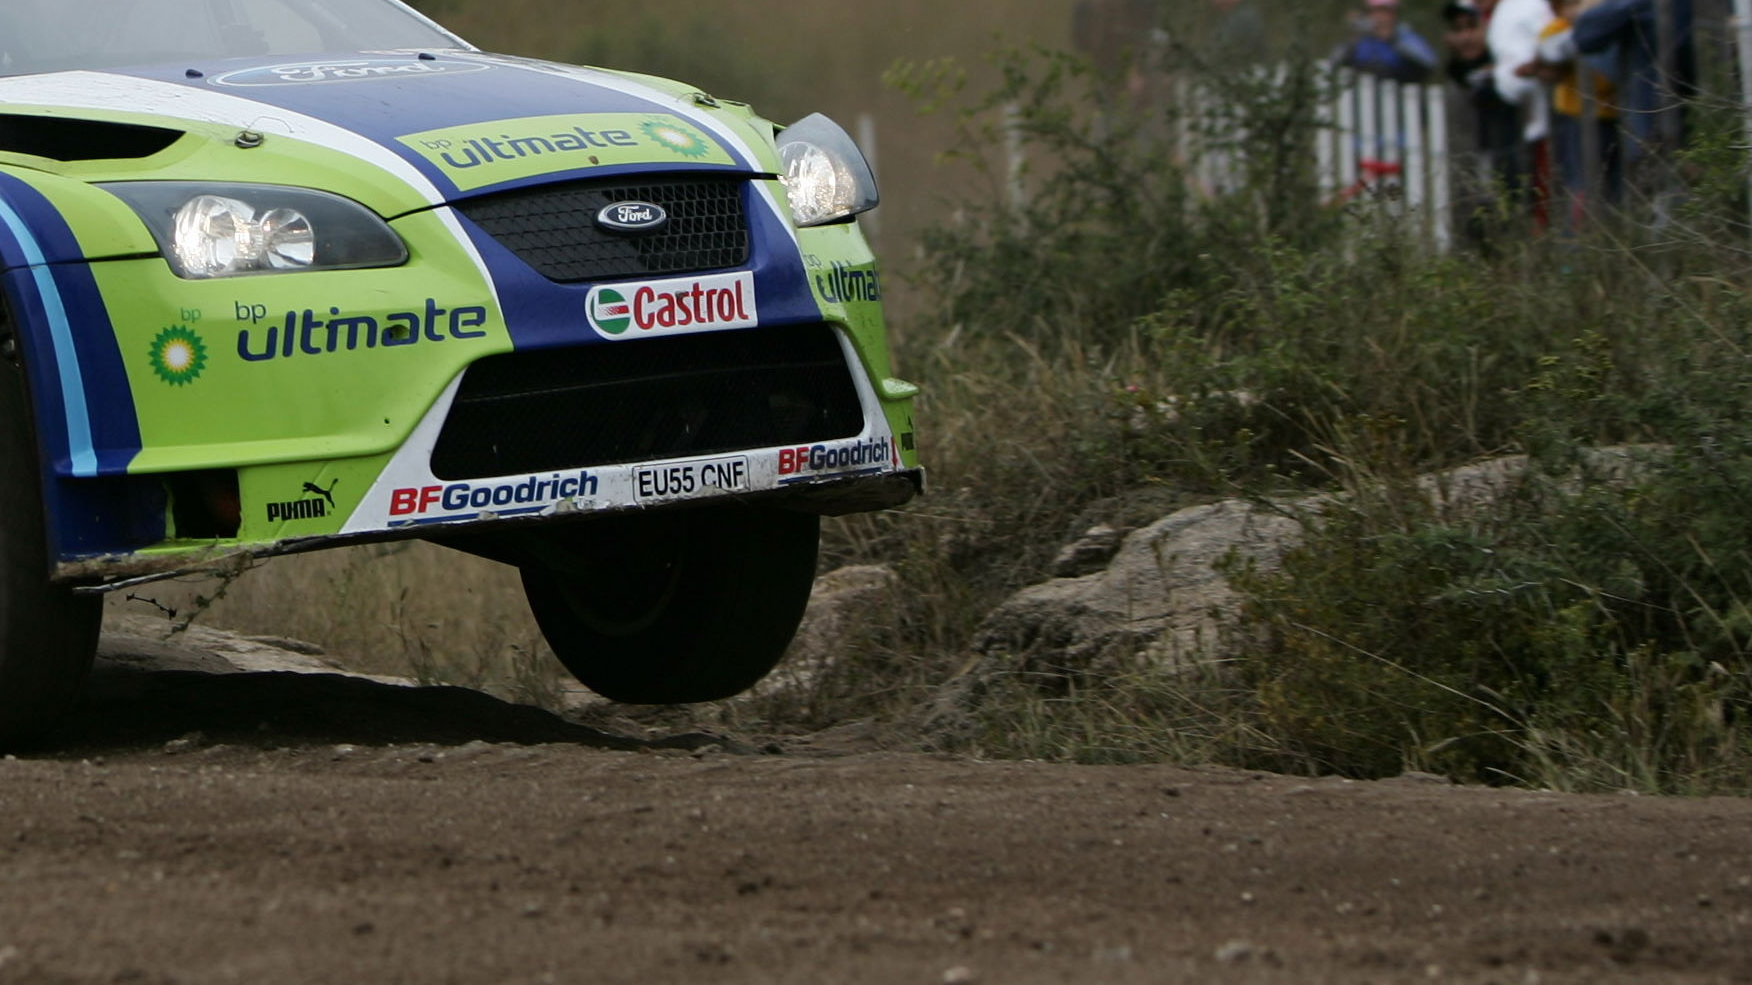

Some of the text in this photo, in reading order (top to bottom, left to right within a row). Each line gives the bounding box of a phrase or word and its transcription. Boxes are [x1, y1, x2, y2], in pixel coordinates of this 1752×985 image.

[270, 61, 445, 82] Ford
[419, 138, 452, 151] bp
[440, 126, 639, 169] ultimate
[617, 205, 654, 224] Ford
[180, 307, 201, 324] bp
[235, 300, 267, 325] bp
[634, 280, 750, 330] Castrol
[237, 297, 487, 362] ultimate
[778, 436, 889, 475] BFGoodrich
[389, 470, 598, 516] BFGoodrich
[638, 461, 746, 498] EU55 CNF
[267, 498, 326, 522] PUMA
